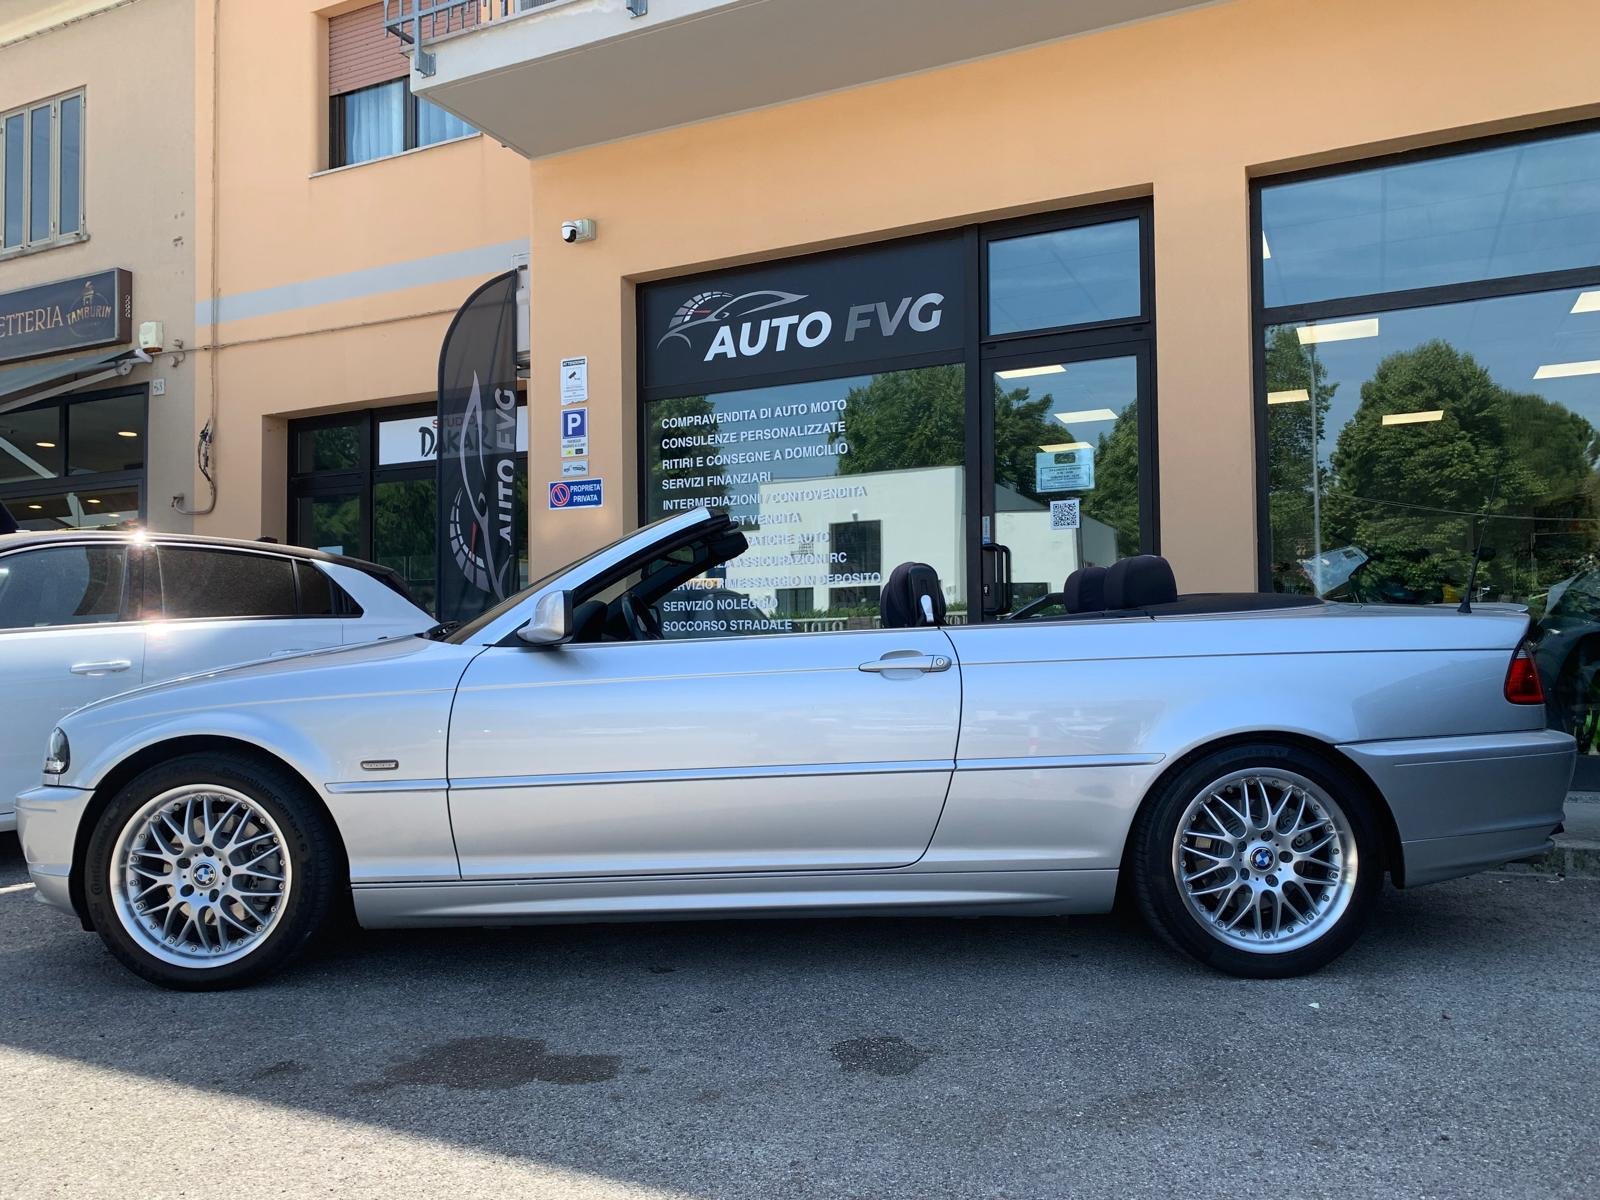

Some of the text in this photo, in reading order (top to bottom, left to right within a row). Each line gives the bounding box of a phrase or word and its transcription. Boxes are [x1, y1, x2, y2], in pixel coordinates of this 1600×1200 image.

[66, 304, 112, 326] TAMBURIN
[704, 292, 944, 362] AUTO FVG
[495, 388, 516, 450] FVG
[662, 399, 847, 429] COMPRAVENDITA DI AUTO MOTO
[568, 413, 581, 436] P
[662, 421, 846, 450] CONSULENZE PERSONALIZZATE
[662, 442, 848, 470] RITIRI E CONSEGNE A DOMICILIO
[662, 472, 771, 490] SERVIZI FINANZIARI
[573, 494, 598, 503] PRIVATA
[663, 494, 762, 510] INTERMEDIAZIONI
[770, 486, 867, 503] CONTOVENDITA
[750, 512, 802, 525] VENDITA
[798, 530, 831, 544] AUTO
[830, 552, 848, 564] RC
[672, 578, 713, 591] RVIZIO
[806, 575, 817, 586] IN
[820, 572, 881, 586] DEPOSITO
[663, 596, 778, 612] SERVIZIO NOLEGGIO
[663, 618, 792, 632] SOCCORSO STRADALE
